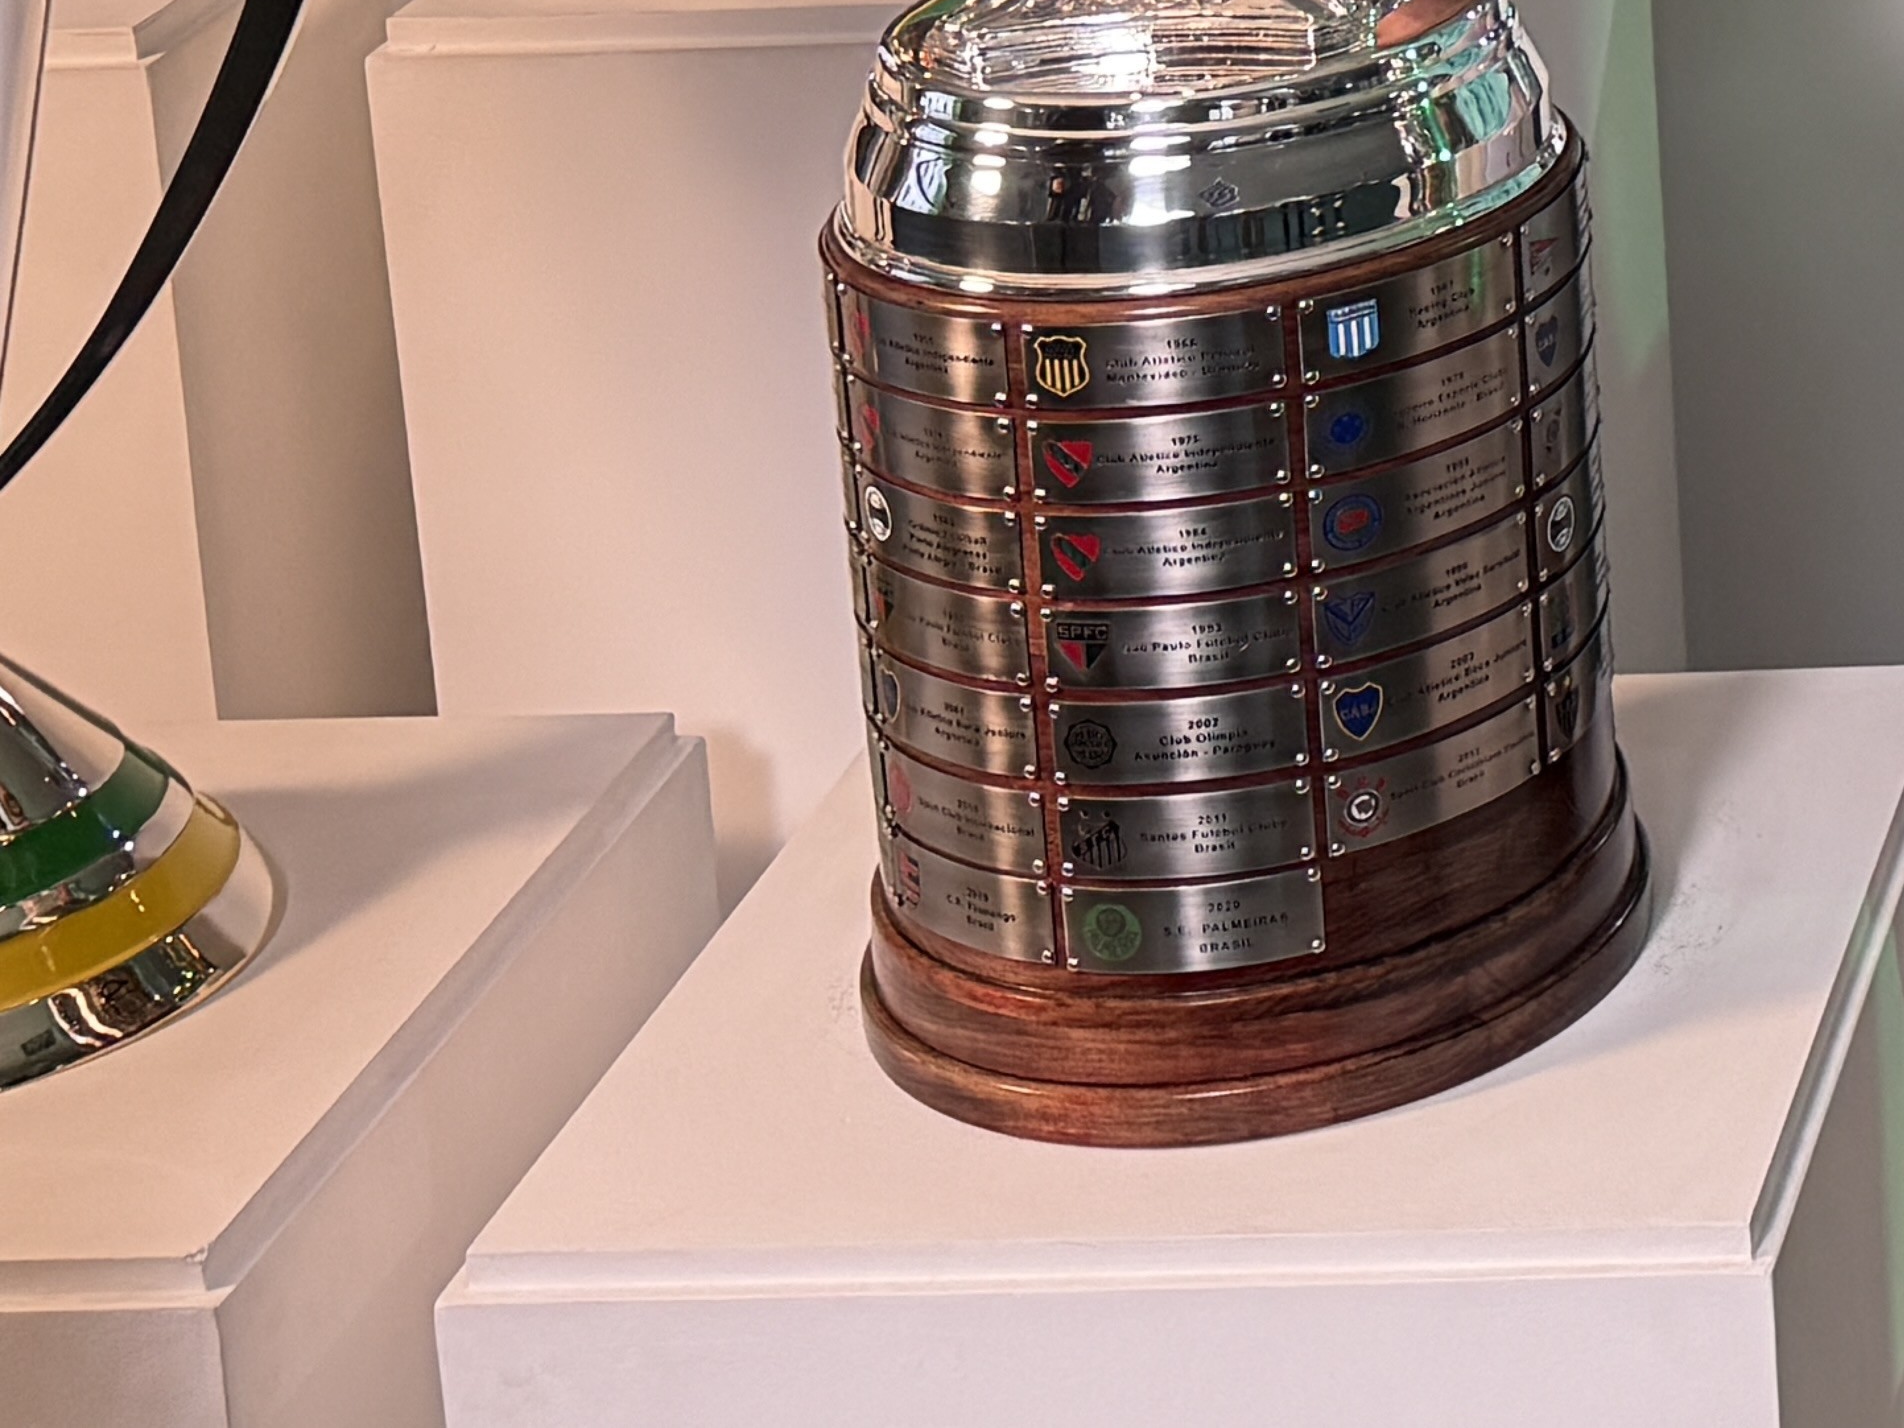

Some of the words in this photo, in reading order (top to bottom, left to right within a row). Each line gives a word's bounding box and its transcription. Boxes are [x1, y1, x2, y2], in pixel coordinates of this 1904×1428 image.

[1056, 622, 1110, 642] SPFC
[1201, 912, 1289, 935] PALMEIRAS
[1198, 937, 1252, 955] BRASIL
